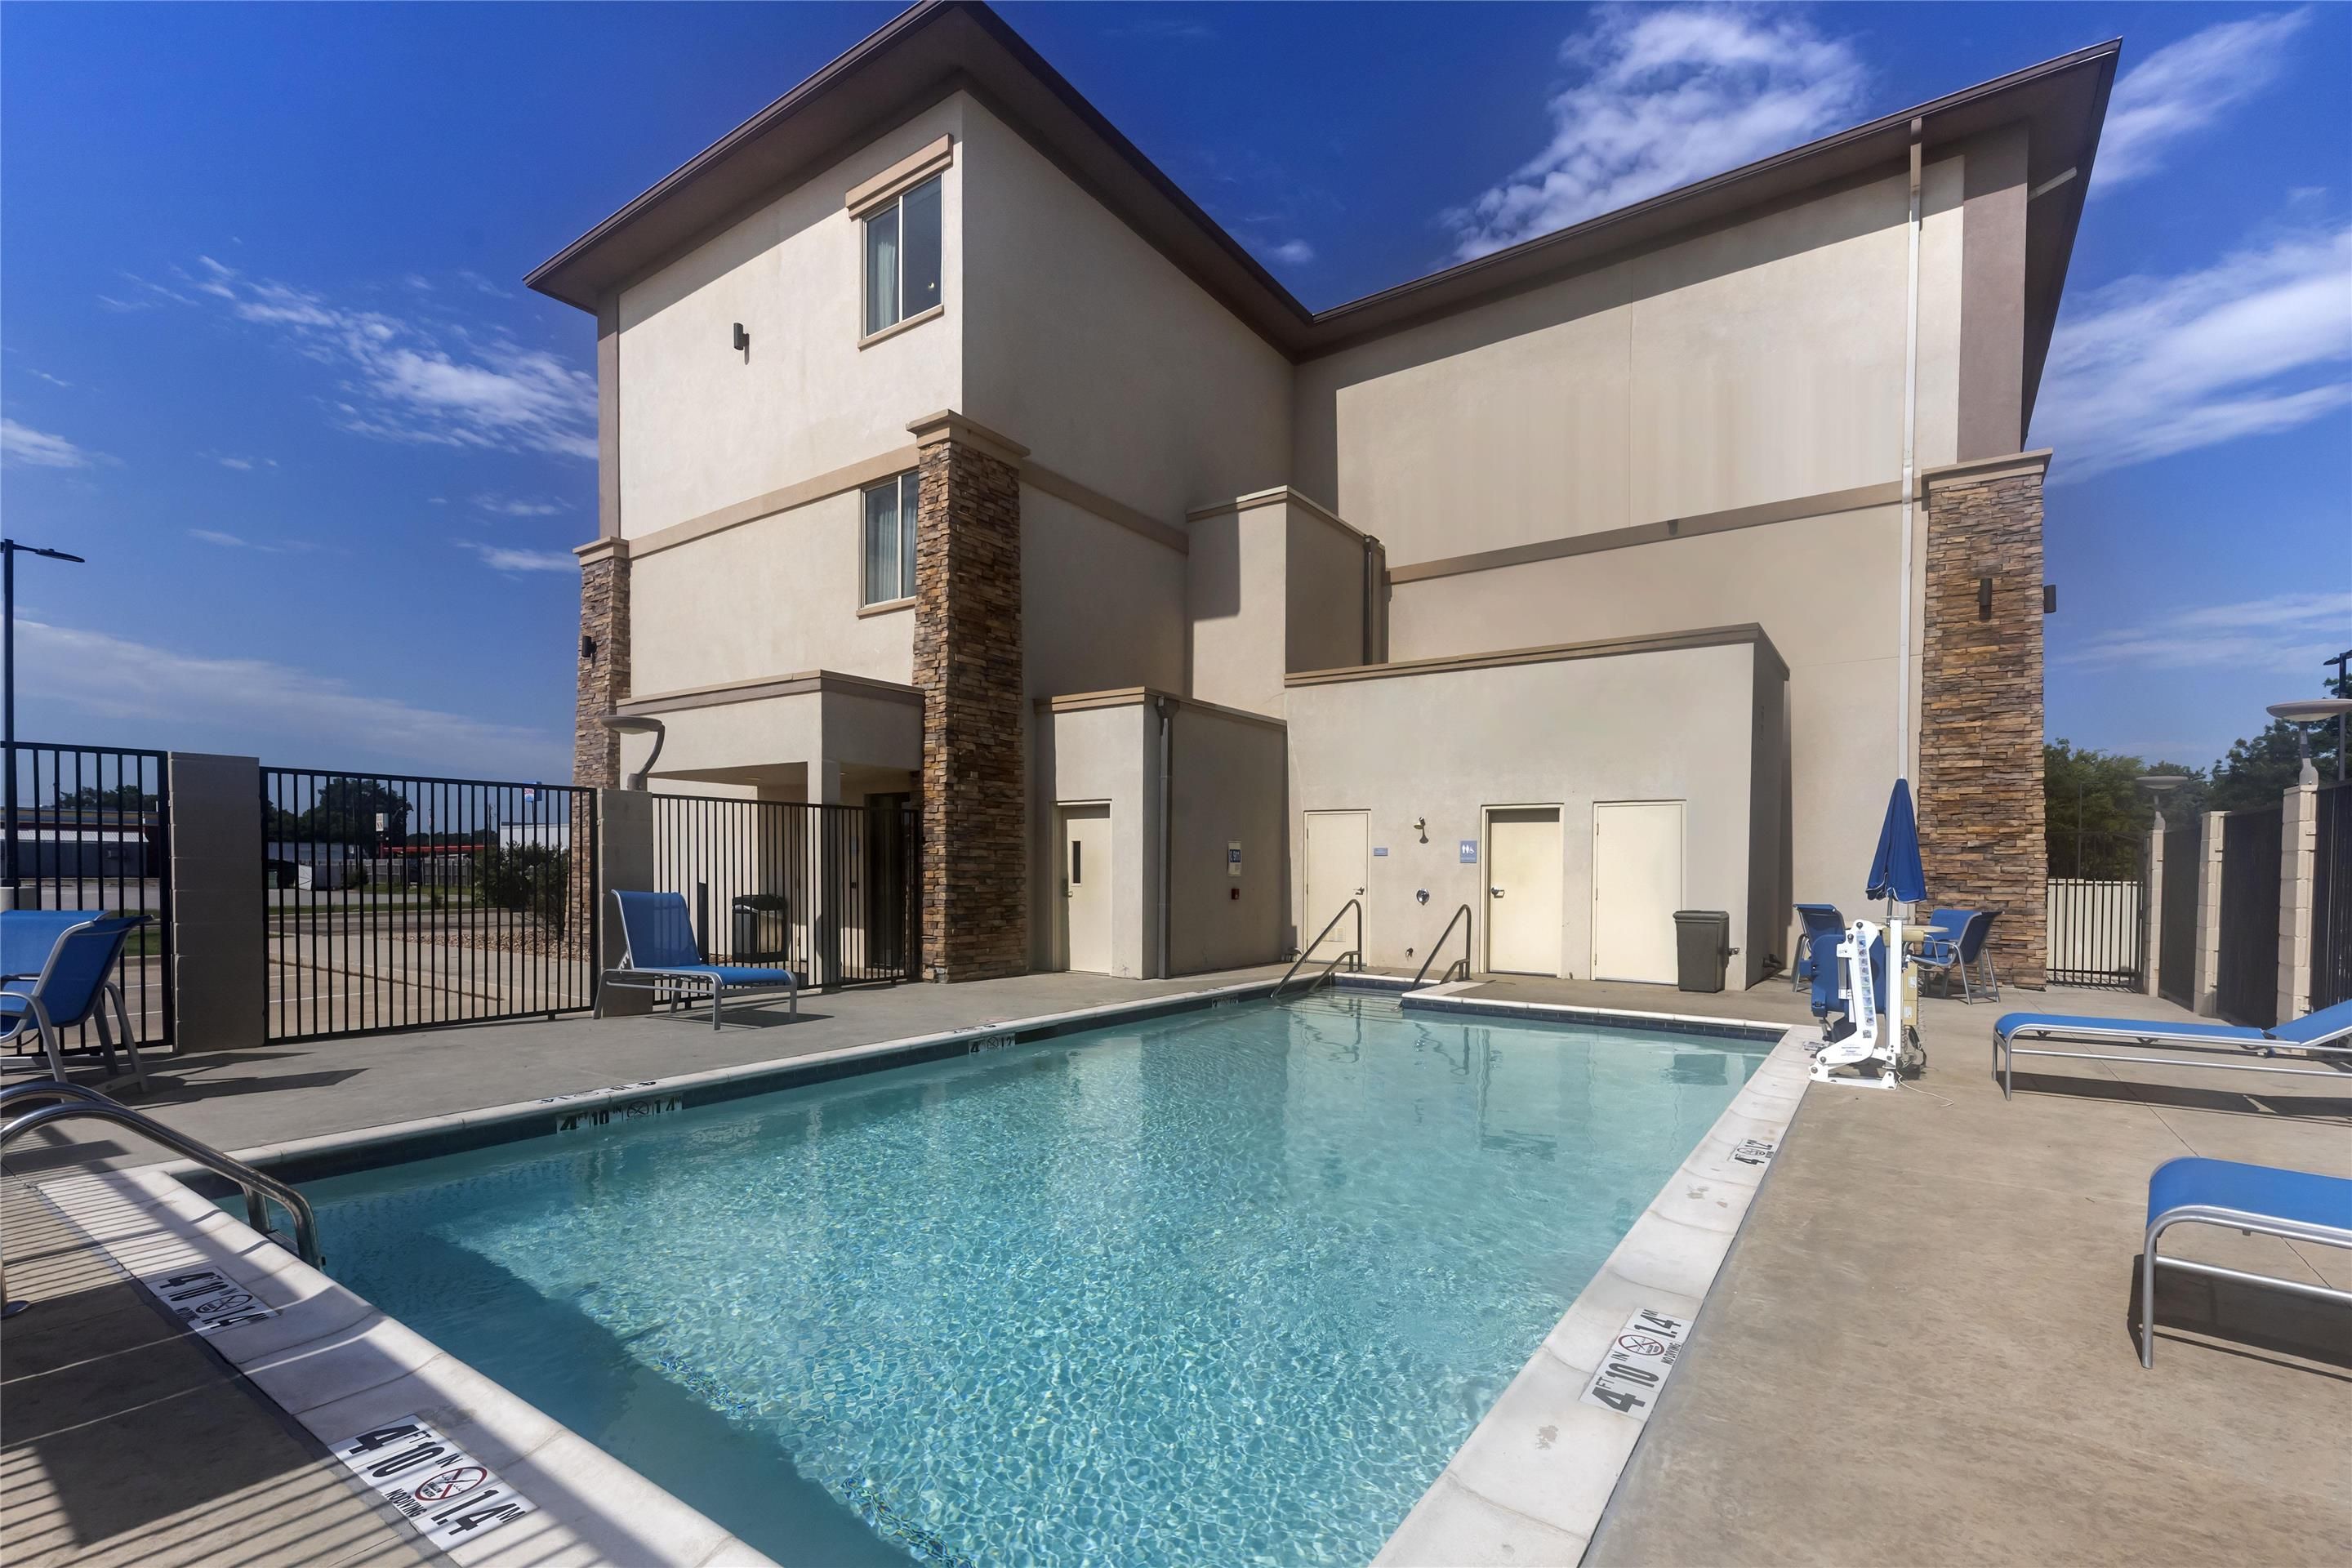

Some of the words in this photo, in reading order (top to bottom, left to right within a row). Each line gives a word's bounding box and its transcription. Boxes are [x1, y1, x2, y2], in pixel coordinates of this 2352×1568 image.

[559, 1116, 580, 1131] 4
[591, 1110, 609, 1125] 10
[1735, 1156, 1766, 1165] 4
[159, 1271, 216, 1290] 4
[167, 1281, 229, 1302] 10
[202, 1306, 266, 1330] 1.4
[1633, 1314, 1682, 1339] 1.4
[1610, 1351, 1630, 1362] IN
[1595, 1376, 1615, 1389] FT
[1605, 1362, 1659, 1388] 10
[1591, 1386, 1646, 1413] 4
[349, 1423, 420, 1455] 4
[403, 1430, 432, 1445] FT
[367, 1441, 445, 1478] 10
[434, 1452, 463, 1468] IN
[384, 1487, 408, 1501] NO
[392, 1494, 428, 1517] DIVING
[431, 1489, 505, 1536] 1.4
[496, 1503, 526, 1524] M
